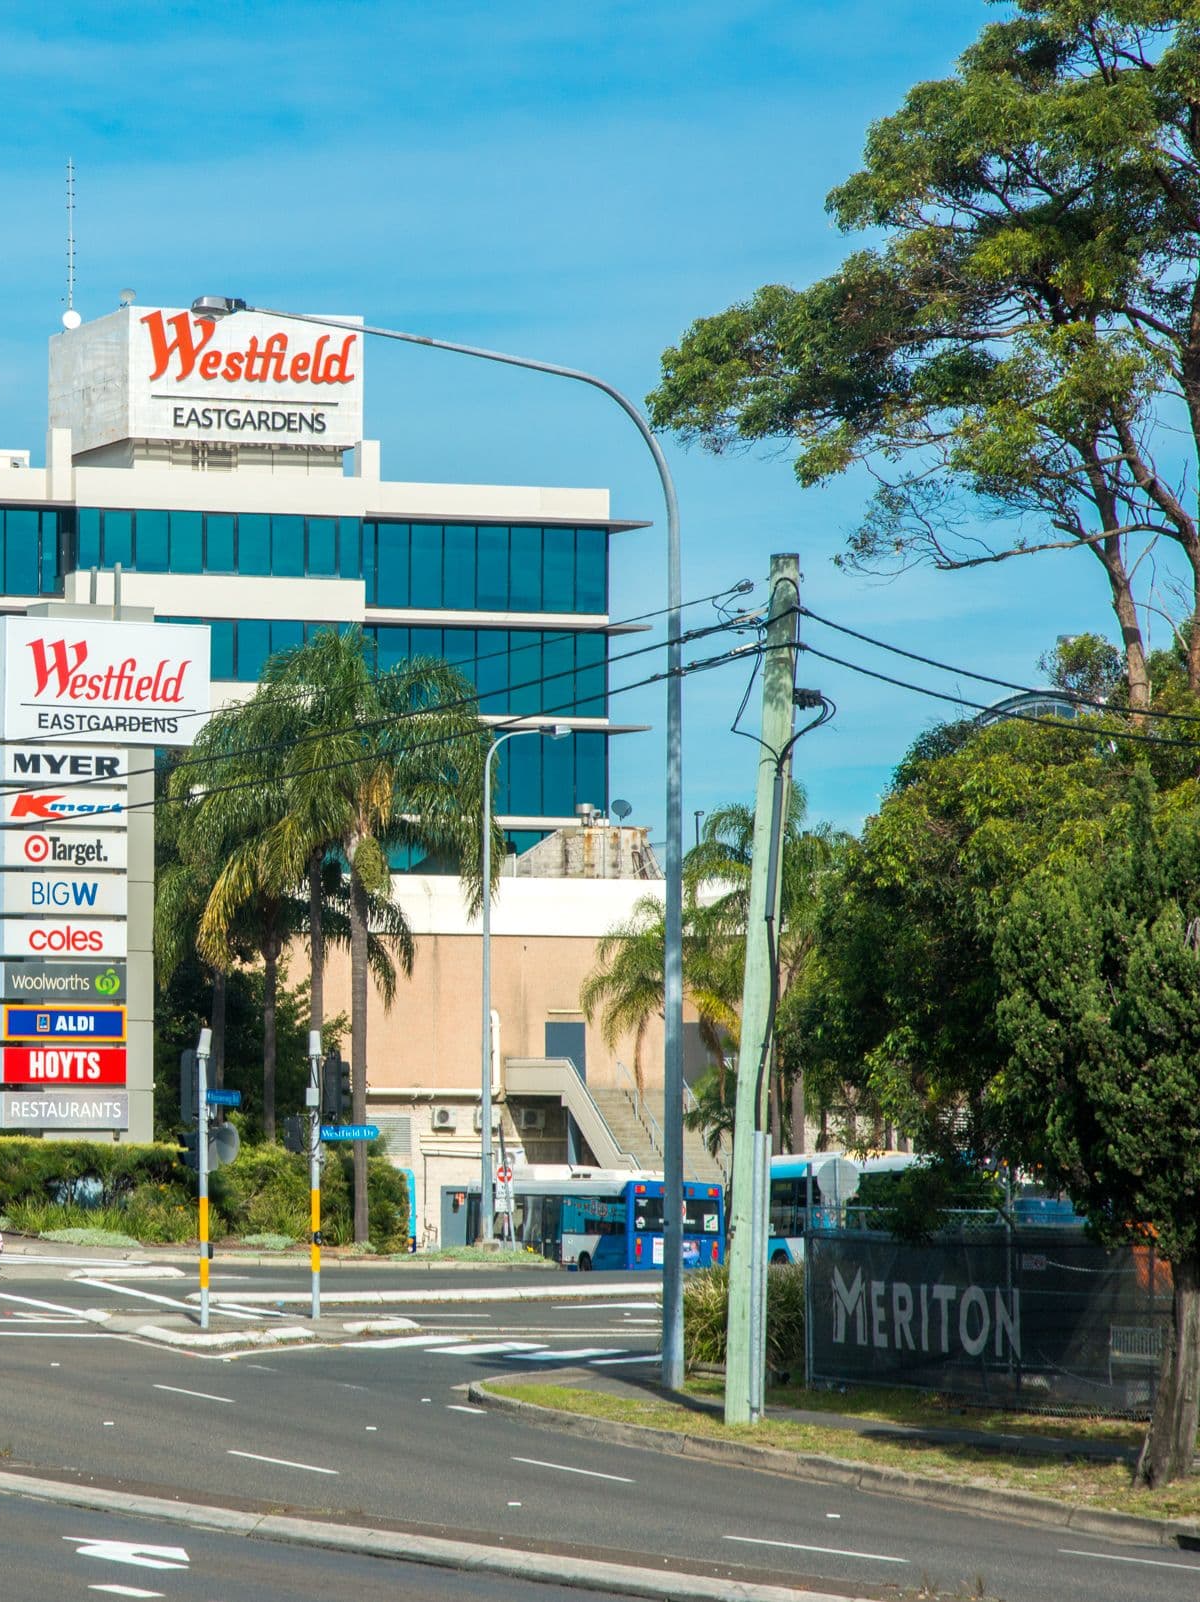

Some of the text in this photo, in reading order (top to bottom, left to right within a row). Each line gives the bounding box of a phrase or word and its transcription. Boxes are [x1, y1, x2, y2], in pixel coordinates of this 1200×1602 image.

[140, 310, 356, 384] Westfield
[173, 407, 327, 433] EASTGARDENS
[25, 638, 192, 703] Westfield
[38, 712, 178, 734] EASTGARDENS
[13, 752, 120, 776] MYER
[10, 794, 122, 819] Kmart
[29, 925, 103, 951] coles
[12, 973, 90, 991] Woolworths
[55, 1015, 94, 1031] ALDI
[29, 1051, 100, 1079] HOYTS
[11, 1102, 121, 1118] RESTAURANTS
[321, 1129, 360, 1137] Westfield
[831, 1265, 1021, 1359] MERITON
